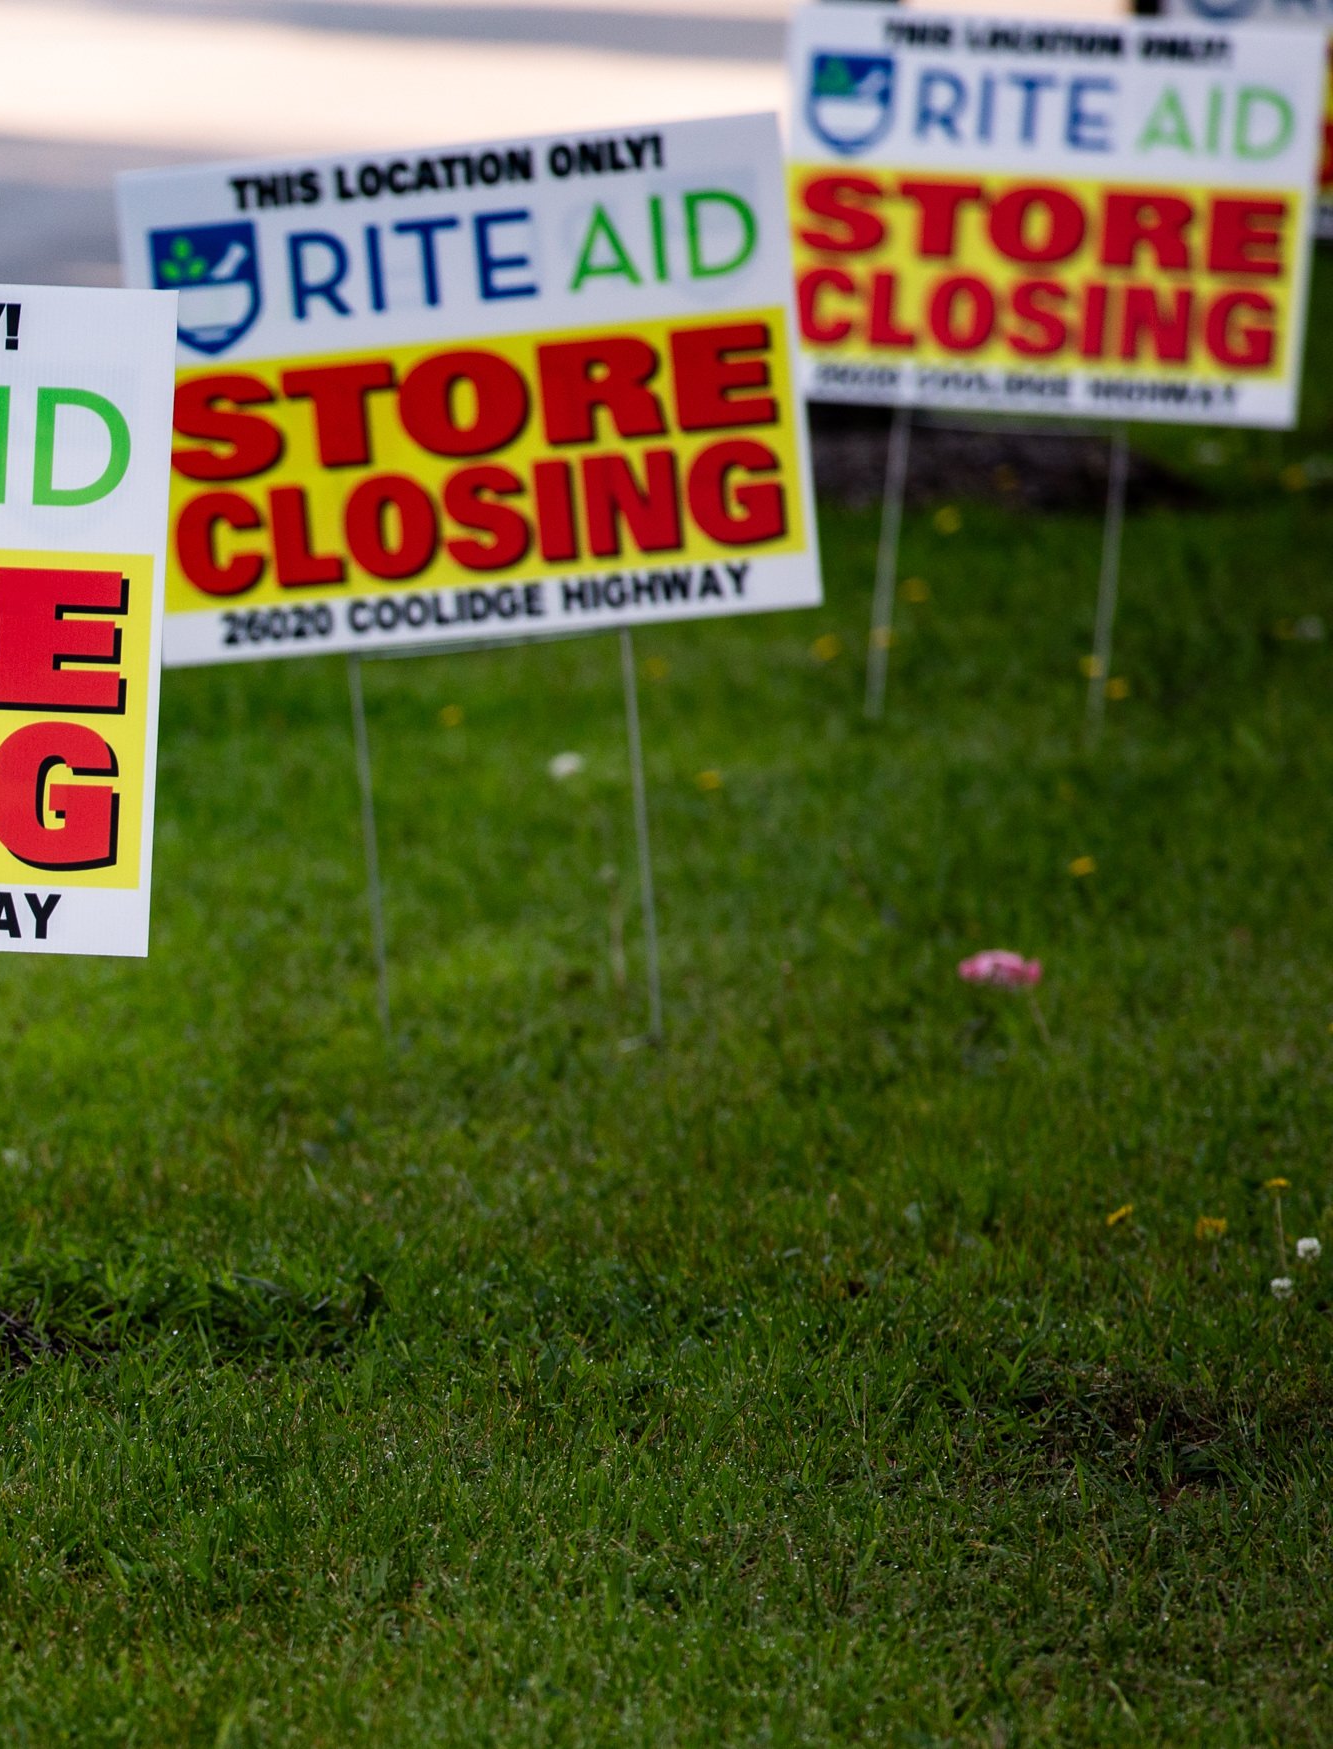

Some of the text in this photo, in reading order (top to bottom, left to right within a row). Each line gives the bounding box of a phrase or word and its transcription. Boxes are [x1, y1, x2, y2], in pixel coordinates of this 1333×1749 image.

[915, 69, 1121, 153] RITE
[1136, 82, 1296, 162] AID
[230, 134, 665, 212] THIS LOCATION ONLY!
[286, 189, 758, 322] RITE AID
[796, 176, 1286, 276] STORE
[796, 268, 1277, 370] CLOSING
[171, 321, 779, 482] STORE
[174, 438, 789, 598] CLOSING
[220, 562, 754, 648] 26020 COOLIDGE HIGHWAY
